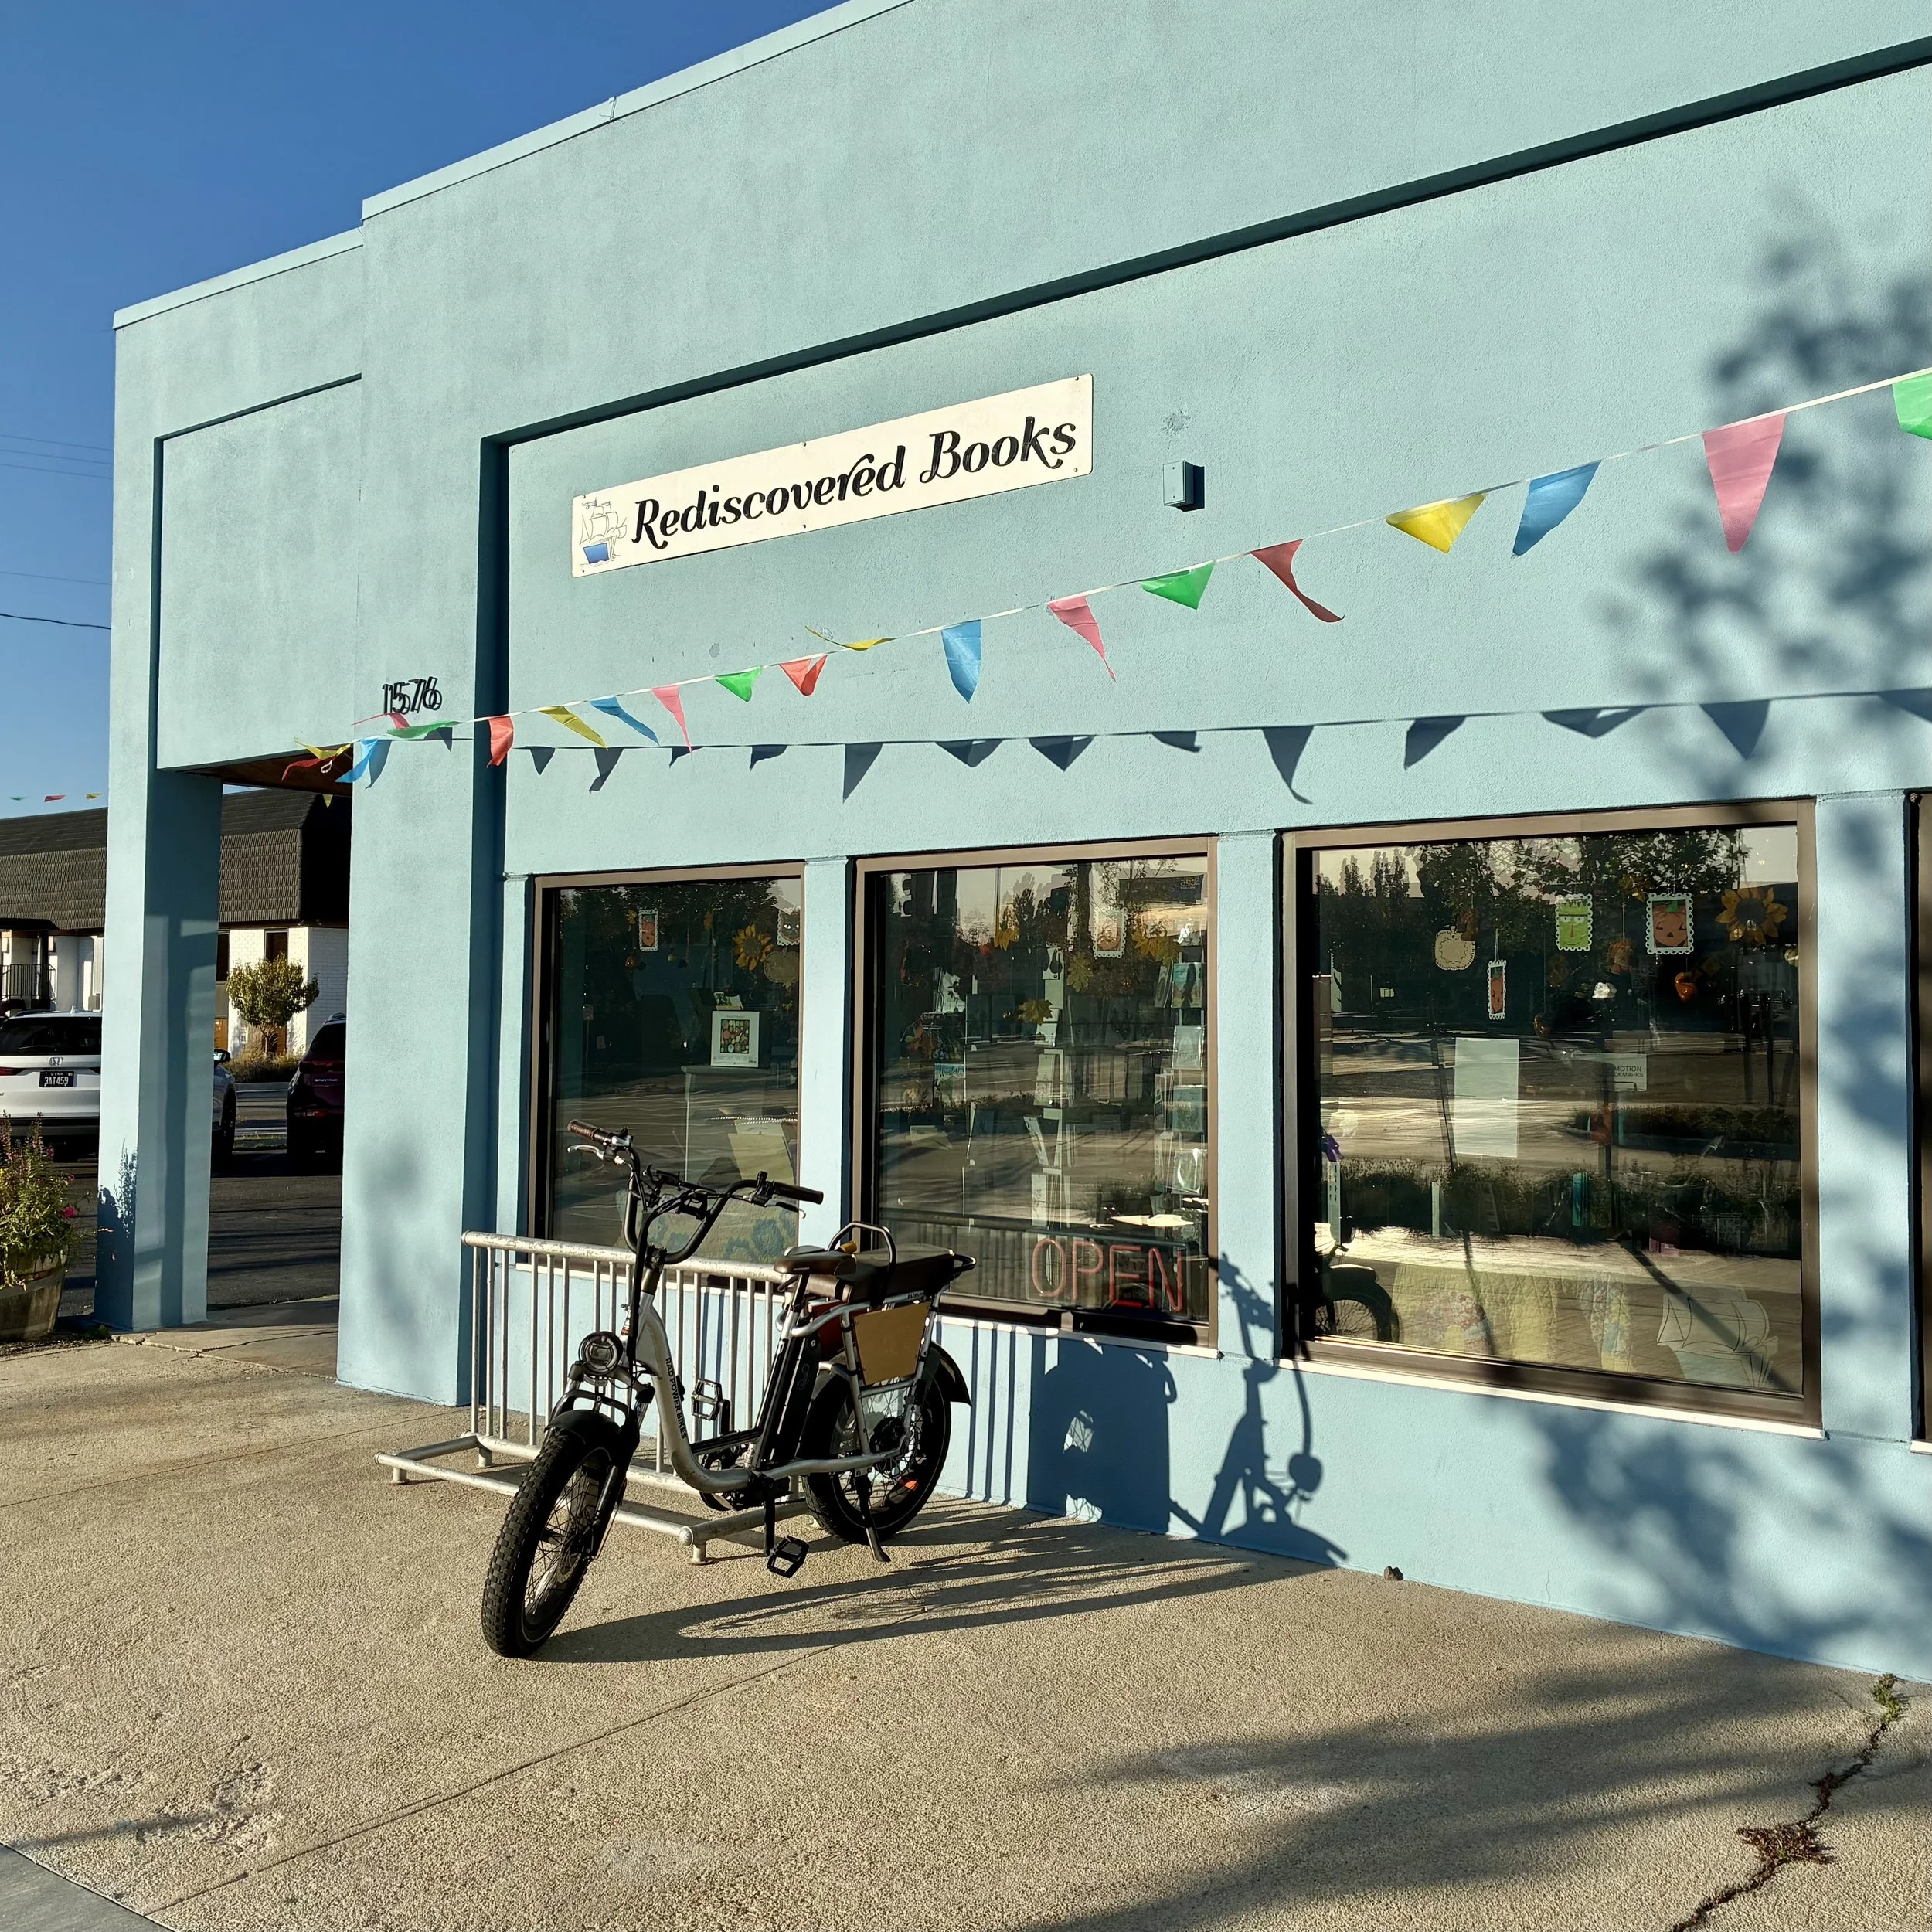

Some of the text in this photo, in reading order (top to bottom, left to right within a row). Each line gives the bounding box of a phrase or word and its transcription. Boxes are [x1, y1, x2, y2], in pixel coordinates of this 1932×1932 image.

[631, 416, 1077, 549] Rediscovered Books
[382, 676, 442, 715] 1576
[1032, 1238, 1183, 1312] OPEN
[666, 1357, 687, 1439] RAD POWER BIKES
